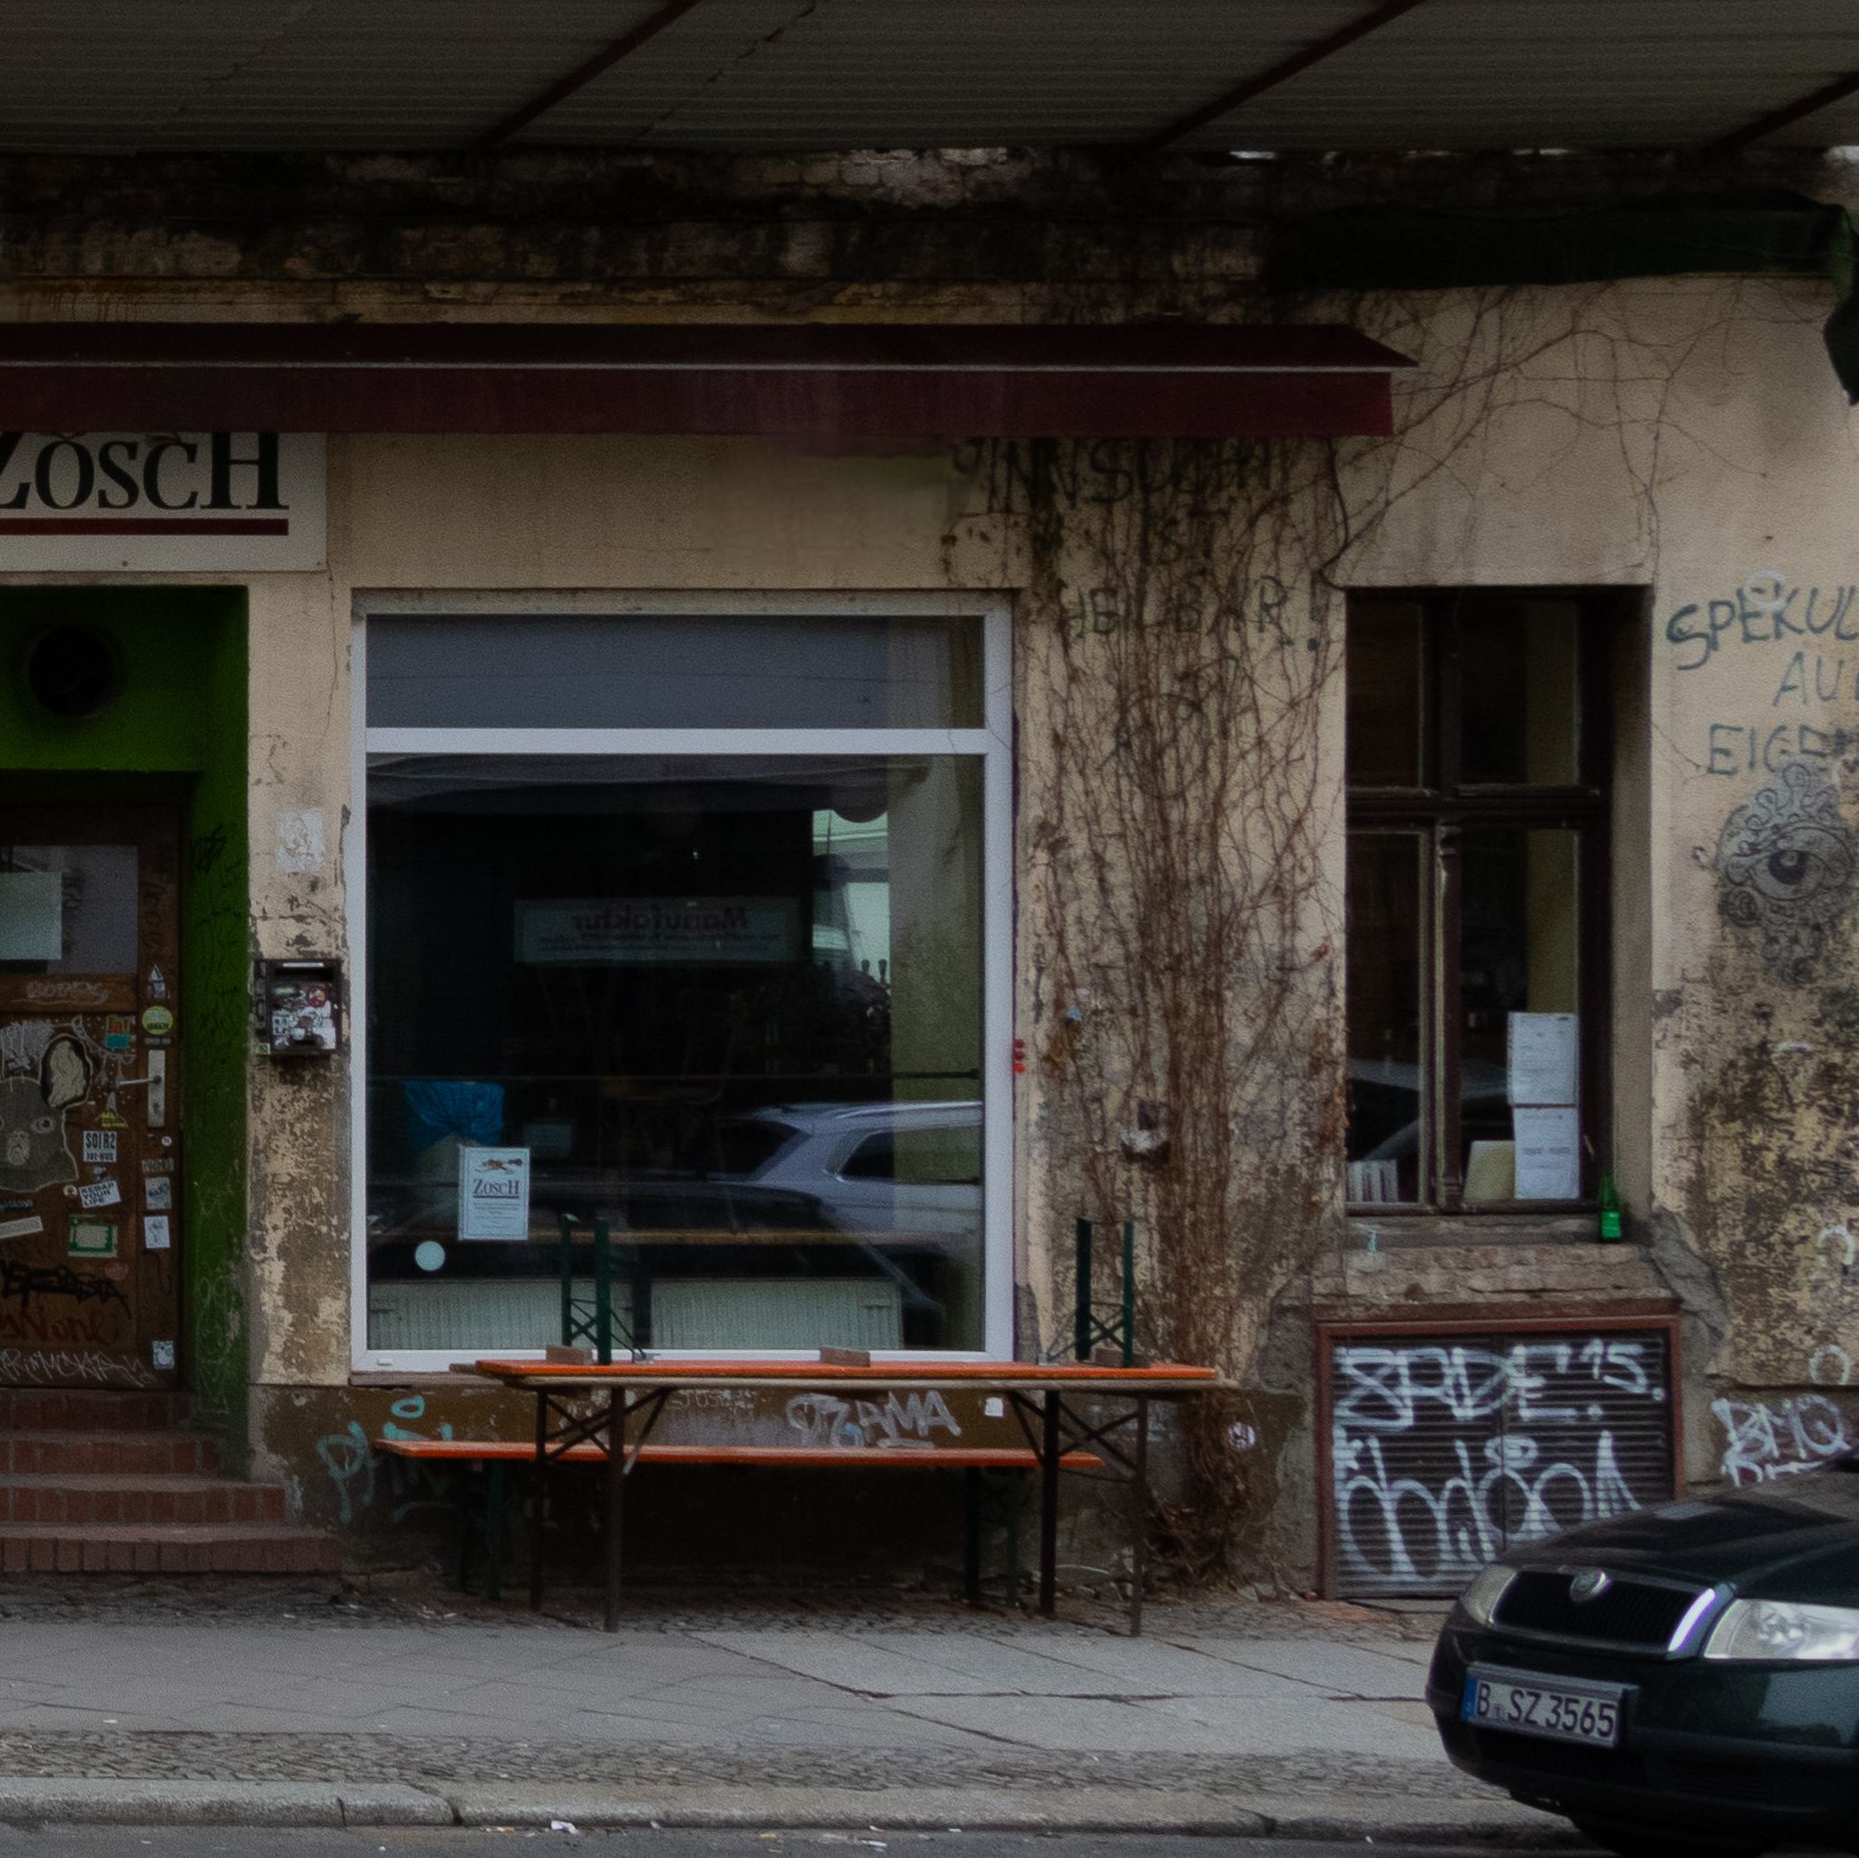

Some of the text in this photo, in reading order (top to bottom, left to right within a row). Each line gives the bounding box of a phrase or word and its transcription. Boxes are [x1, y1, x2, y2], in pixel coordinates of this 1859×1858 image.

[1477, 1683, 1617, 1738] B SZ 3565
